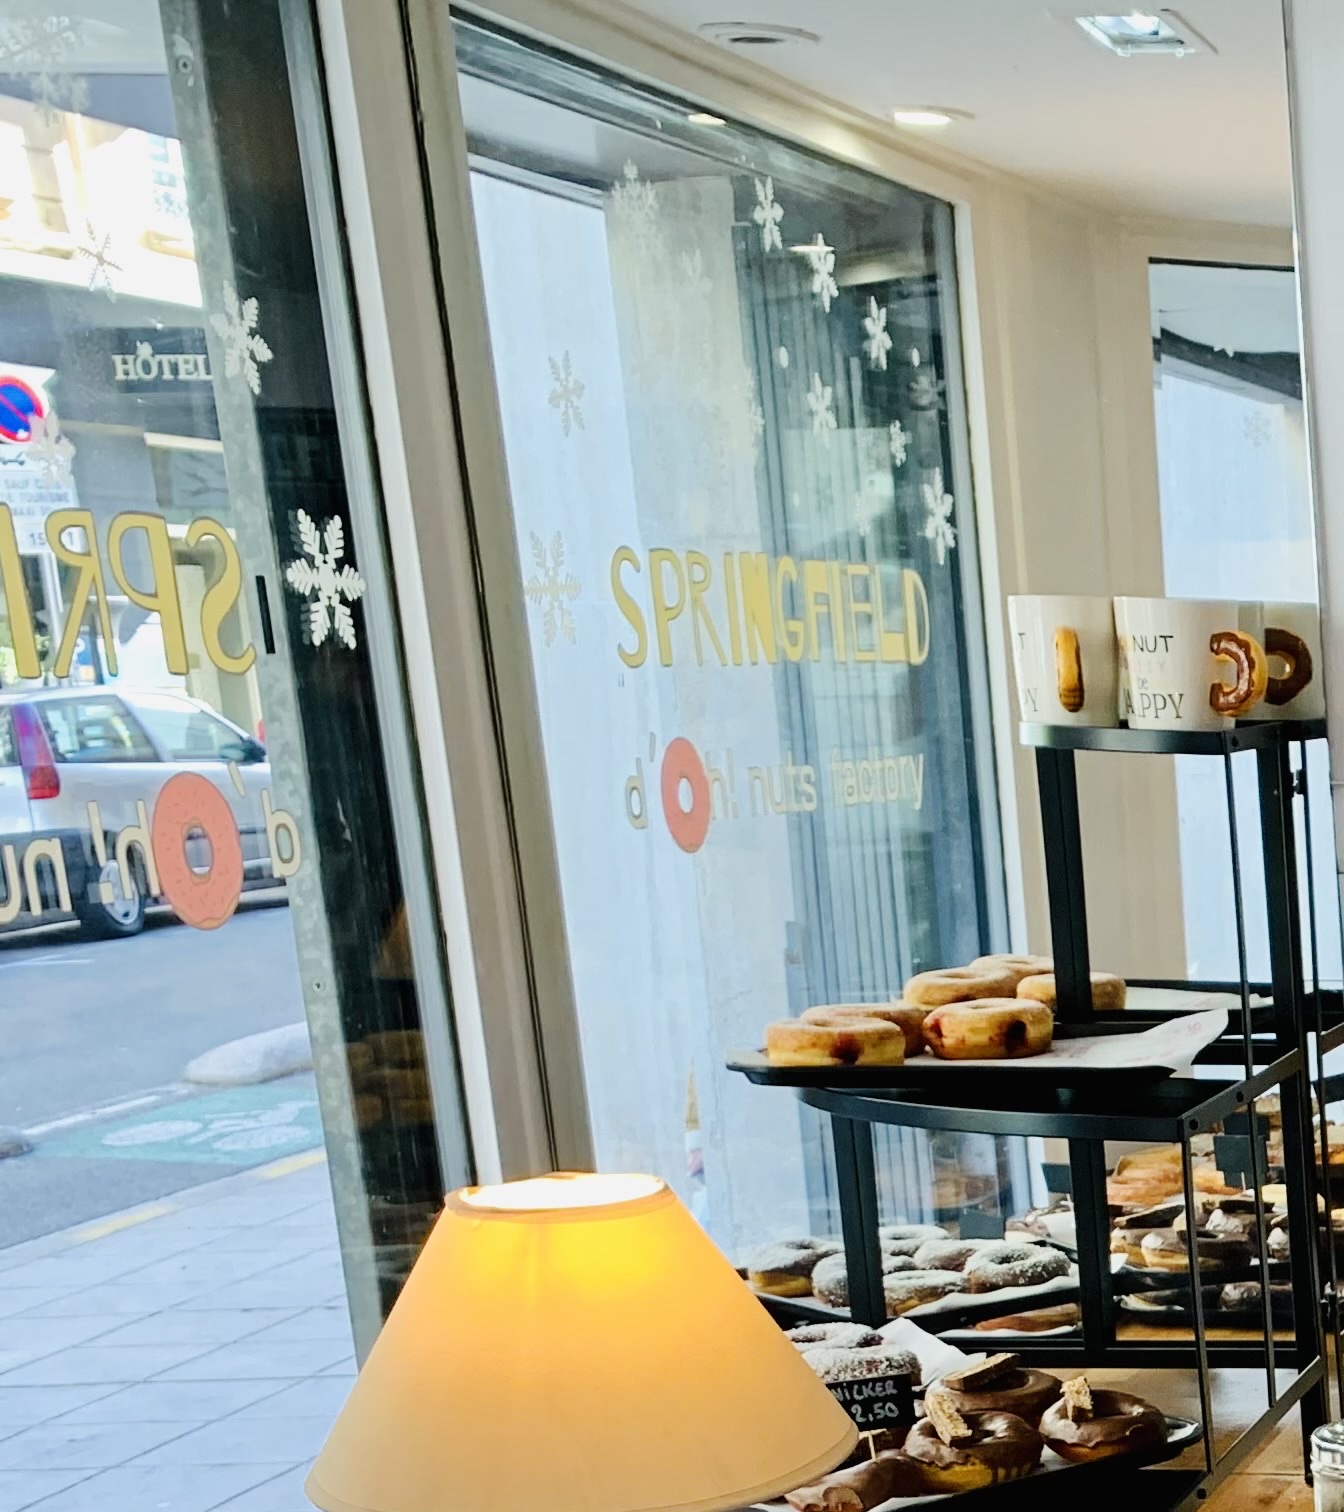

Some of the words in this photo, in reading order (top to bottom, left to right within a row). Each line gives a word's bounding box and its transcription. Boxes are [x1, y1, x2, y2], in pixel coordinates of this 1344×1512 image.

[610, 545, 931, 668] SPRINGFIELD
[828, 747, 925, 811] factory
[830, 1380, 898, 1402] NICKER
[850, 1402, 900, 1423] 2,50
